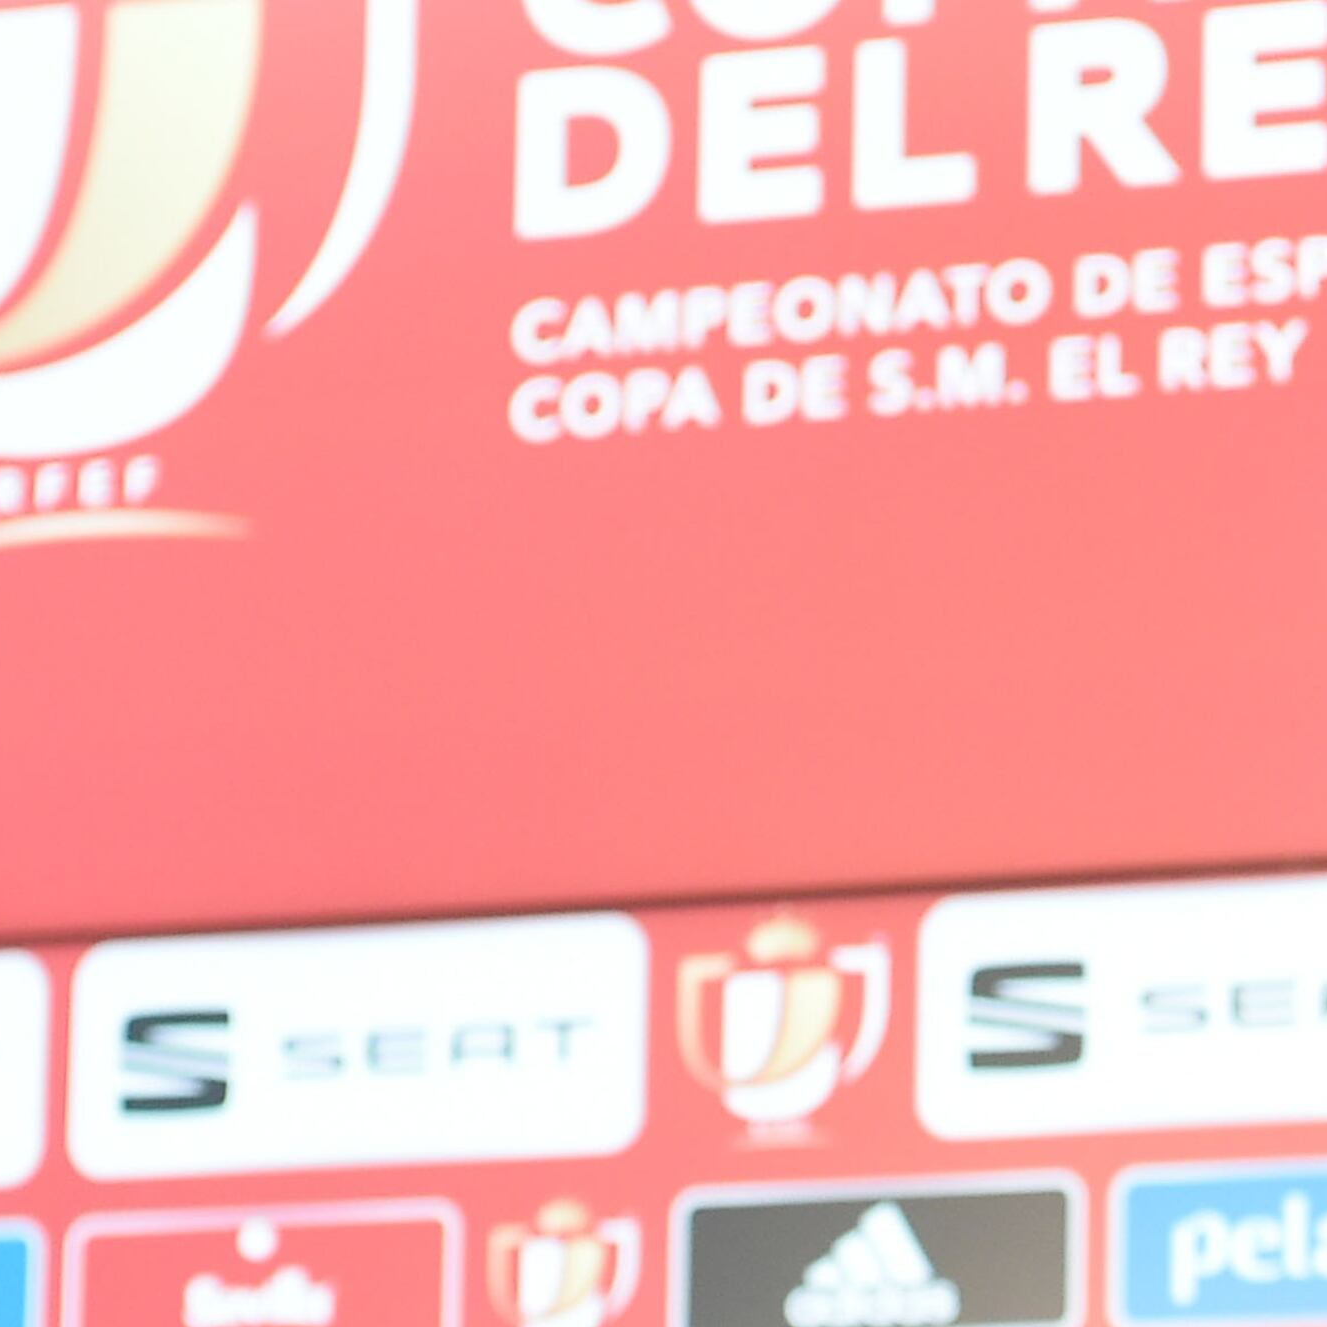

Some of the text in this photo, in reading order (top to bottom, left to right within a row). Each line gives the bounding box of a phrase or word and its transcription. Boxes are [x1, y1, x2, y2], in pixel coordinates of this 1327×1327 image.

[513, 37, 978, 241] DEL
[510, 256, 1053, 365] CAMPEONATO
[1072, 248, 1179, 318] DE
[508, 317, 1308, 444] COPA DE S.M. EL REY
[278, 1015, 595, 1082] SEAT
